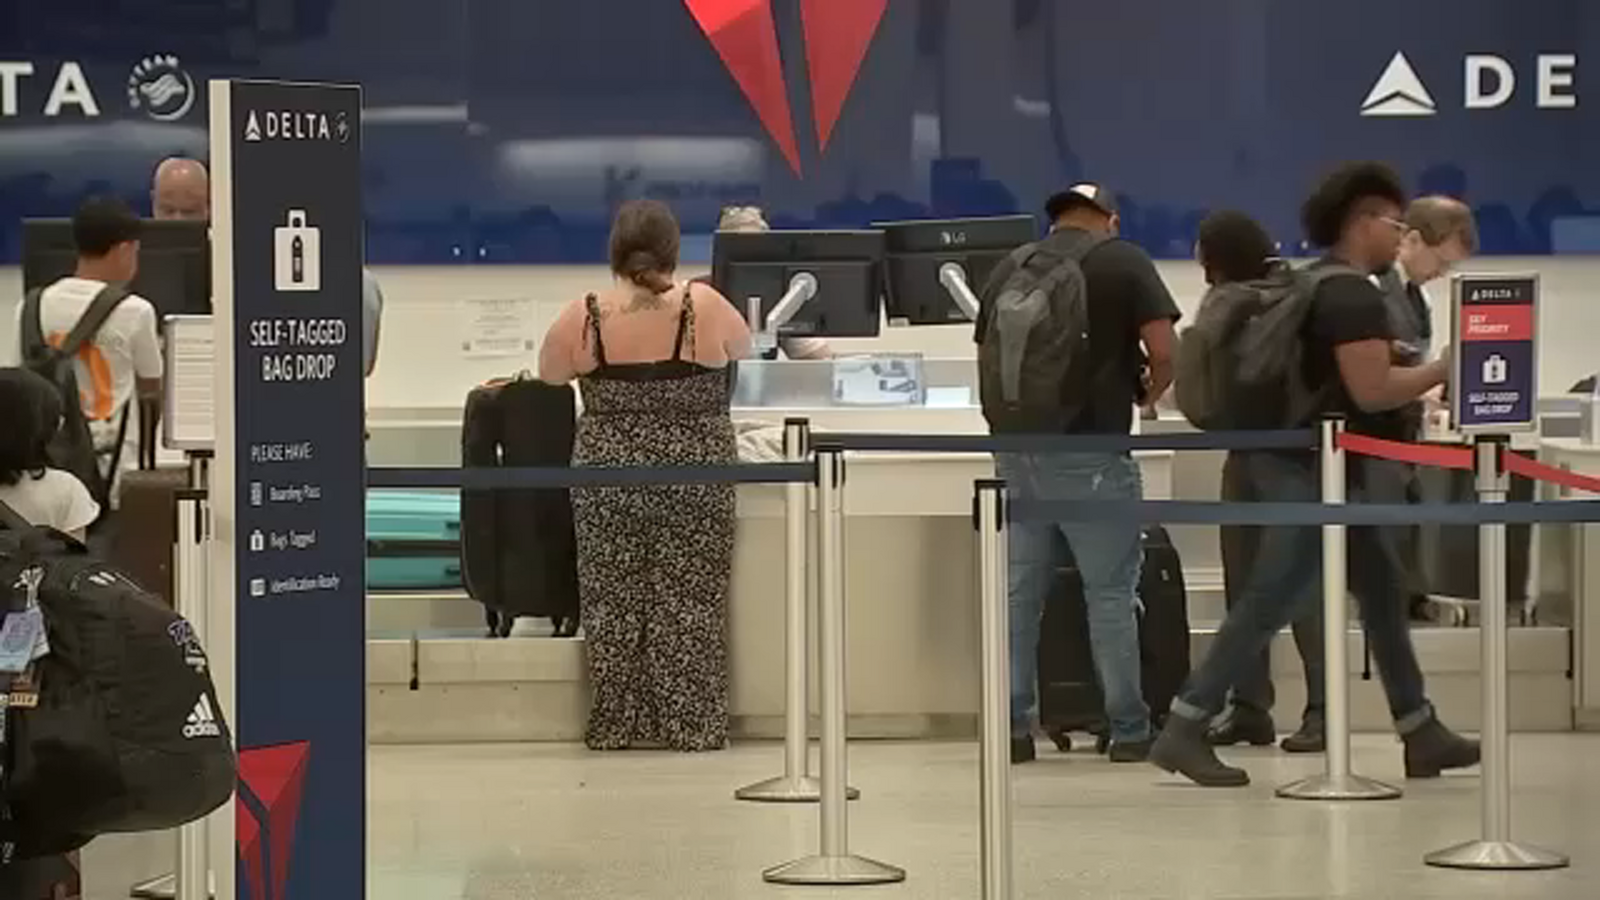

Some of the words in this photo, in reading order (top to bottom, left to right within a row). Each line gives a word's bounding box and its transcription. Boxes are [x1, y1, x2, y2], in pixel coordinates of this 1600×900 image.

[0, 62, 99, 115] TA
[1464, 54, 1576, 108] DE
[266, 111, 331, 140] DELTA
[1481, 288, 1512, 299] DELTA
[250, 319, 346, 346] SELF-TAGGED
[263, 355, 293, 381] BAG
[296, 354, 335, 380] DROP
[251, 443, 283, 462] PLEASE
[270, 484, 303, 503] Boarding
[304, 484, 321, 499] Pass
[271, 531, 288, 551] Bags
[290, 530, 316, 549] Tagged
